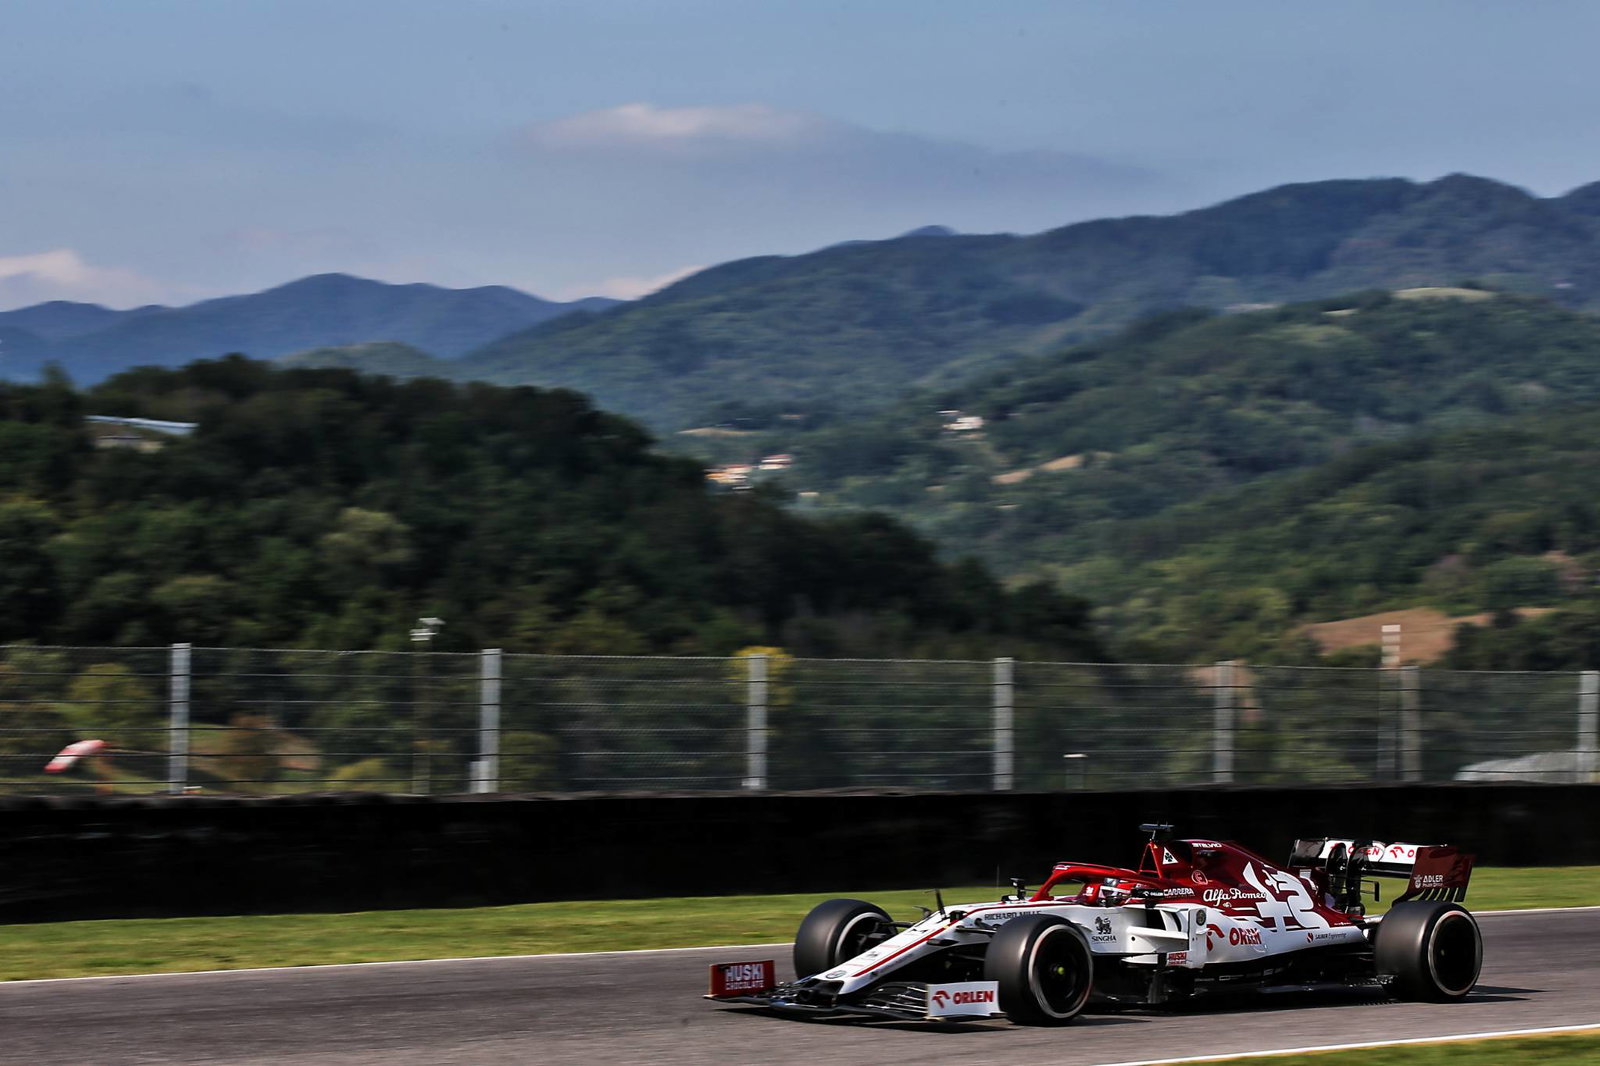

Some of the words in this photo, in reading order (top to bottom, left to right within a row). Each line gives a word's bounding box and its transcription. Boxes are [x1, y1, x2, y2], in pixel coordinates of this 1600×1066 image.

[1422, 875, 1444, 883] ADLER
[1163, 888, 1194, 896] CARRERA
[1203, 889, 1231, 906] Alfa
[1229, 888, 1267, 899] Romeo
[984, 911, 1017, 920] RICHARD
[725, 964, 763, 982] HUSKI
[725, 980, 764, 991] CHOCOLATE
[952, 990, 994, 1004] ORLEN
